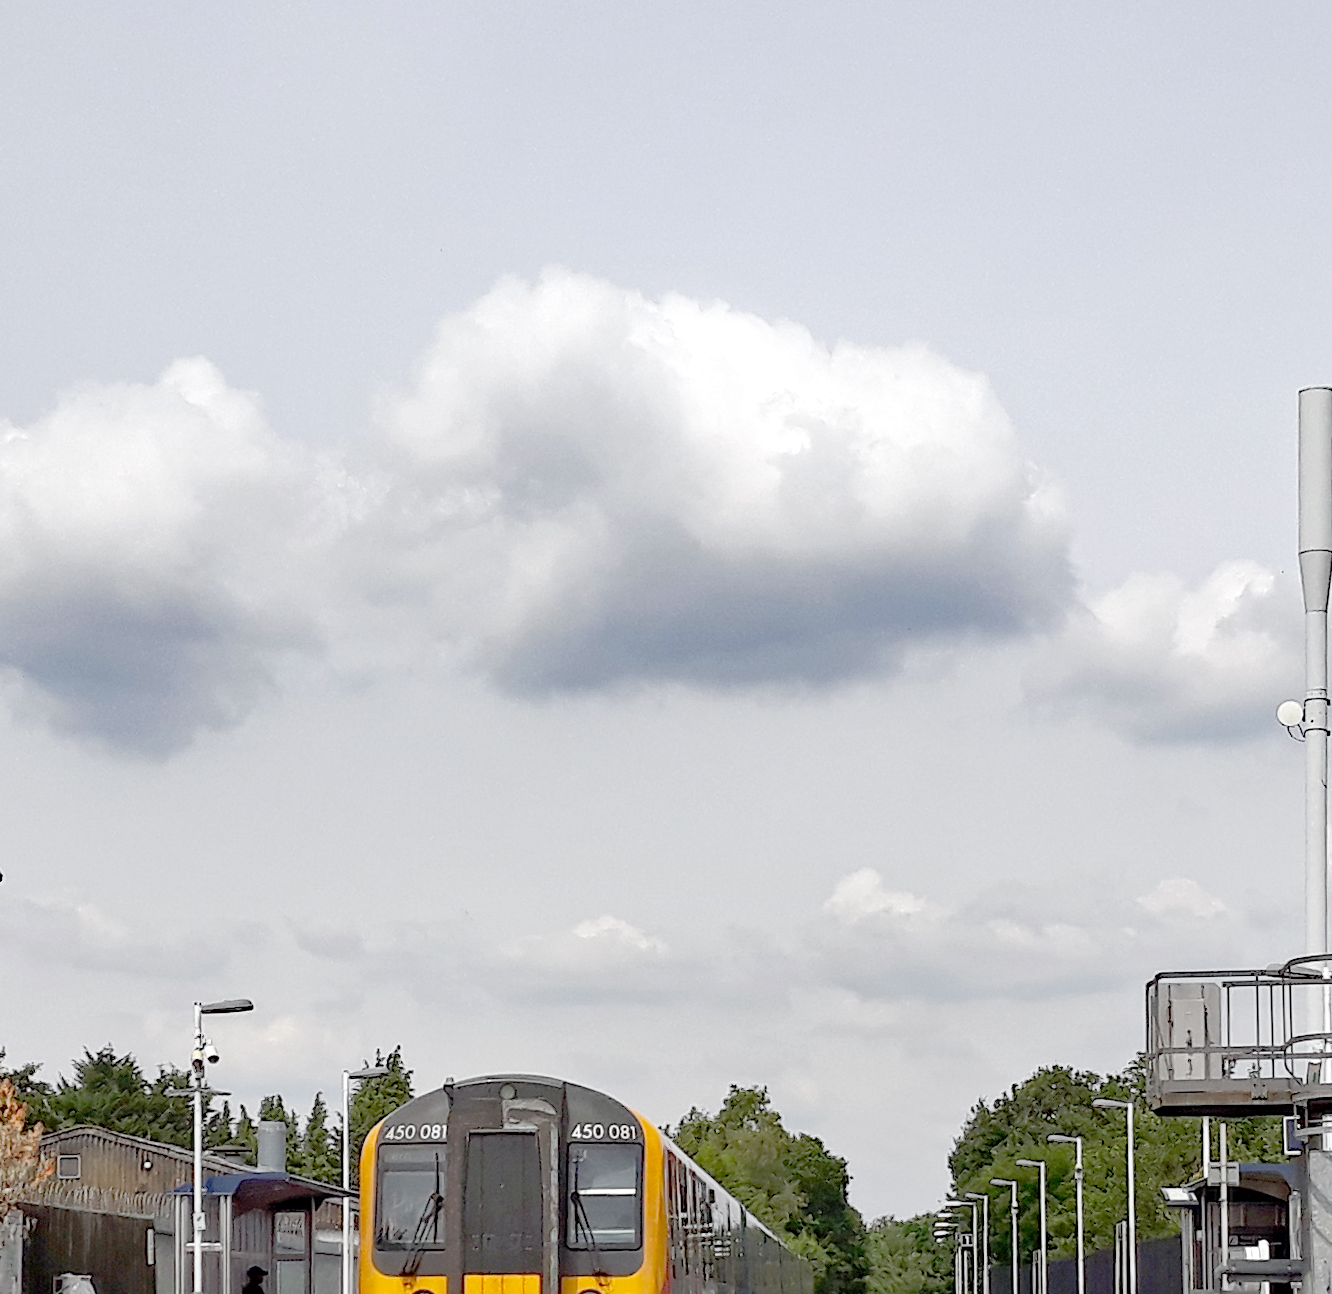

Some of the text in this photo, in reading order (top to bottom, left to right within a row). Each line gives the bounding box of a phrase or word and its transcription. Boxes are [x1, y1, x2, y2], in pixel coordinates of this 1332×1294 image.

[384, 1123, 447, 1140] 450 081
[571, 1123, 637, 1140] 450 081
